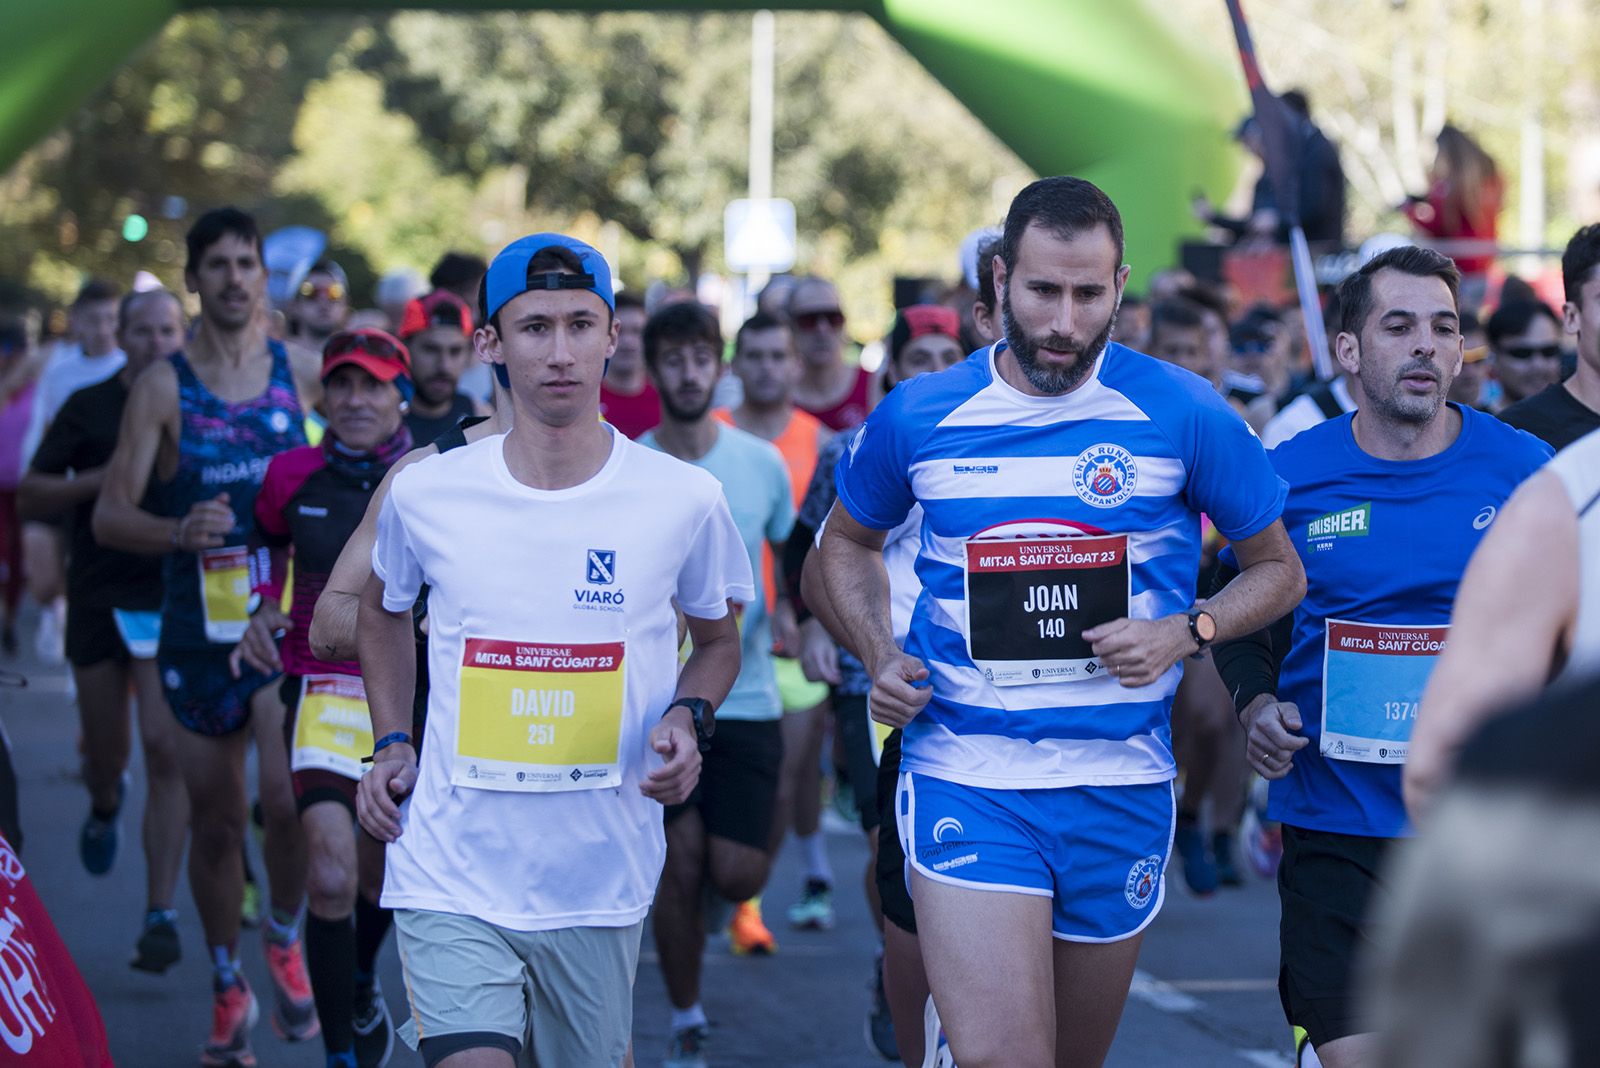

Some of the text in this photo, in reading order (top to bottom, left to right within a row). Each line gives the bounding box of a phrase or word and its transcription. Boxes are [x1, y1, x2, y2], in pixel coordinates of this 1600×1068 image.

[1075, 446, 1136, 488] PENYA RUNNERS
[1082, 490, 1129, 505] ESPANYOL
[1019, 544, 1073, 554] UNIVERSAE
[979, 551, 1116, 567] MITJA SANT CUGAT 23
[574, 588, 625, 605] VIARÓ
[1023, 584, 1078, 613] JOAN
[573, 603, 625, 613] GLOBAL SCHOOL
[1037, 618, 1065, 638] 140
[1378, 631, 1430, 641] UNIVERSAE
[516, 646, 572, 657] UNIVERSAE
[1340, 636, 1447, 651] MITJA SANT CUGA
[475, 652, 614, 668] MITJA SANT CUGAT 23
[511, 687, 575, 717] DAVID
[527, 723, 555, 745] 251
